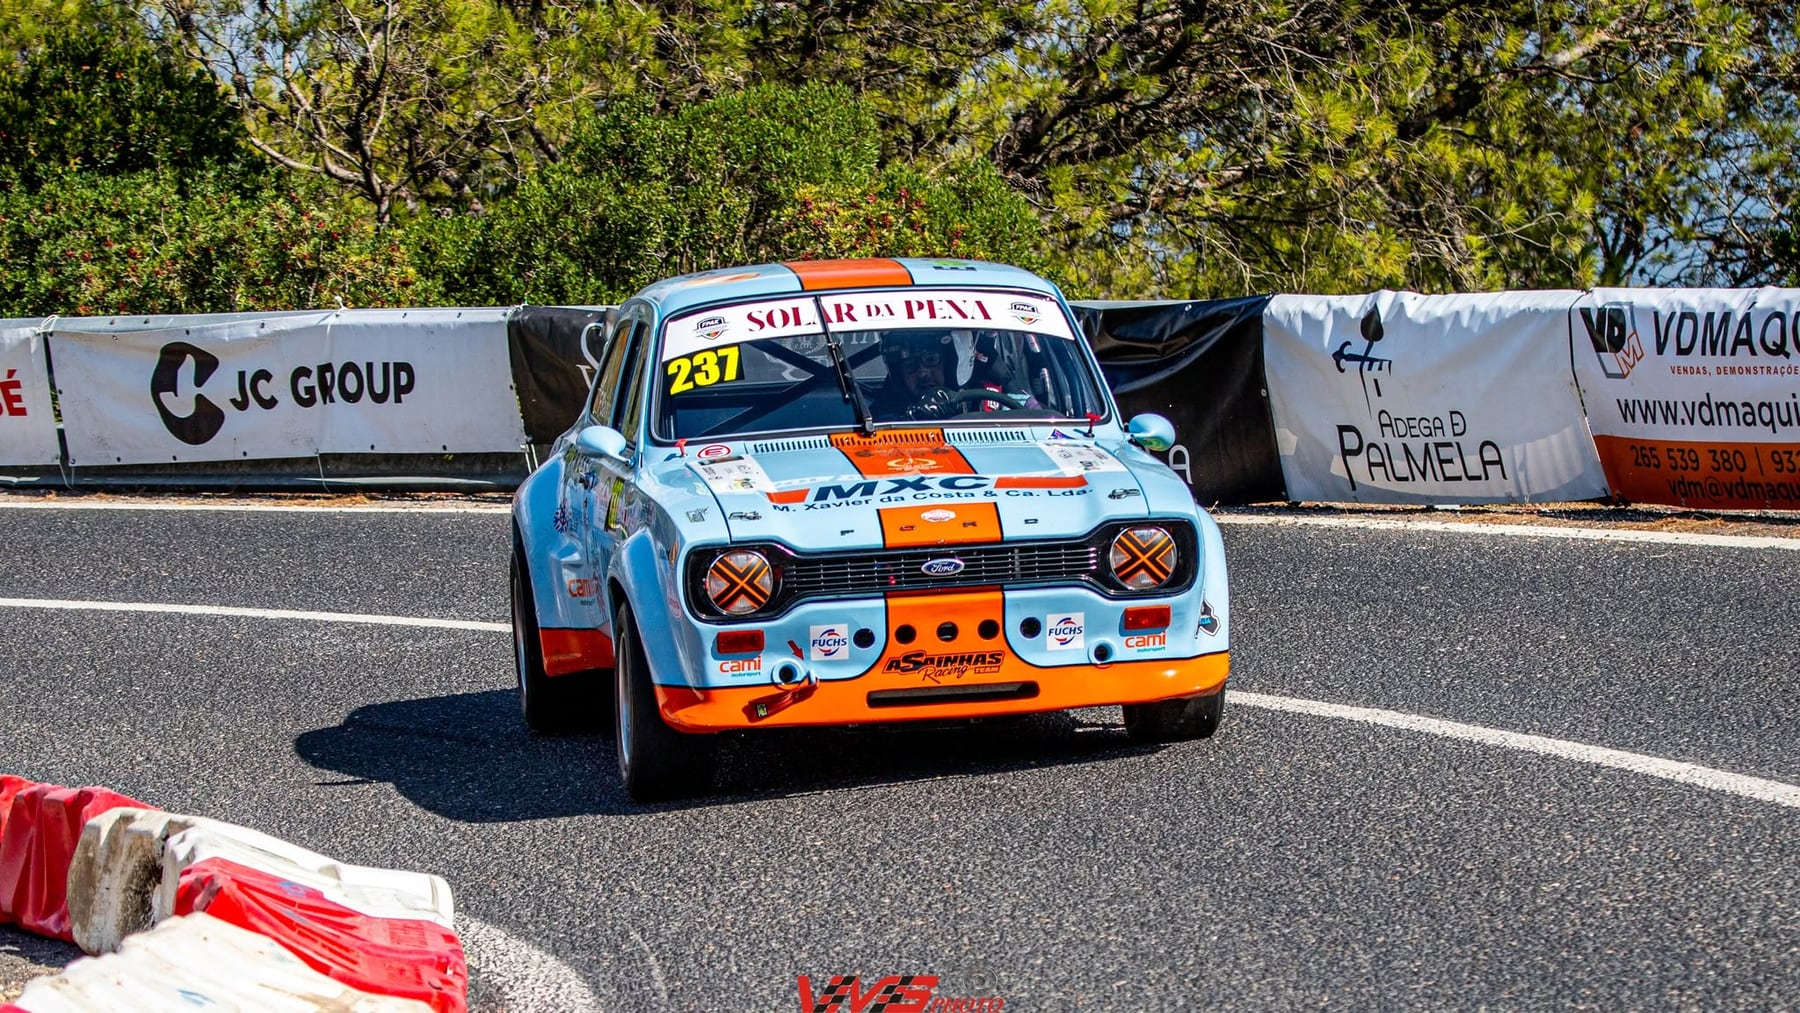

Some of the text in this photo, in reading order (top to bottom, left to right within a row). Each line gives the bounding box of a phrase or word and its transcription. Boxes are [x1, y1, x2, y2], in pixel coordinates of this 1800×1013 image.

[747, 303, 858, 331] SOLAR
[866, 304, 895, 317] DA
[904, 300, 992, 320] PENA
[1653, 301, 1800, 359] VDMÁQ
[667, 346, 739, 395] 237
[1670, 366, 1712, 376] VENDAS,
[229, 361, 415, 411] JC GROUP
[1378, 409, 1445, 438] ADEGA
[1336, 424, 1508, 491] PALMELA
[1630, 445, 1661, 469] 265
[1666, 448, 1700, 471] 539
[1708, 449, 1747, 472] 380
[1771, 450, 1800, 473] 93
[773, 505, 797, 513] M.
[805, 499, 873, 511] Xavier
[880, 494, 905, 503] da
[912, 488, 976, 500] Costa
[1005, 489, 1041, 497] Ca.
[814, 476, 991, 502] MXC
[931, 562, 955, 574] Ford
[812, 638, 847, 648] FUCHS
[1048, 626, 1083, 637] FUCHS
[1125, 631, 1166, 648] cami
[720, 656, 762, 672] cami
[918, 664, 968, 684] Racing
